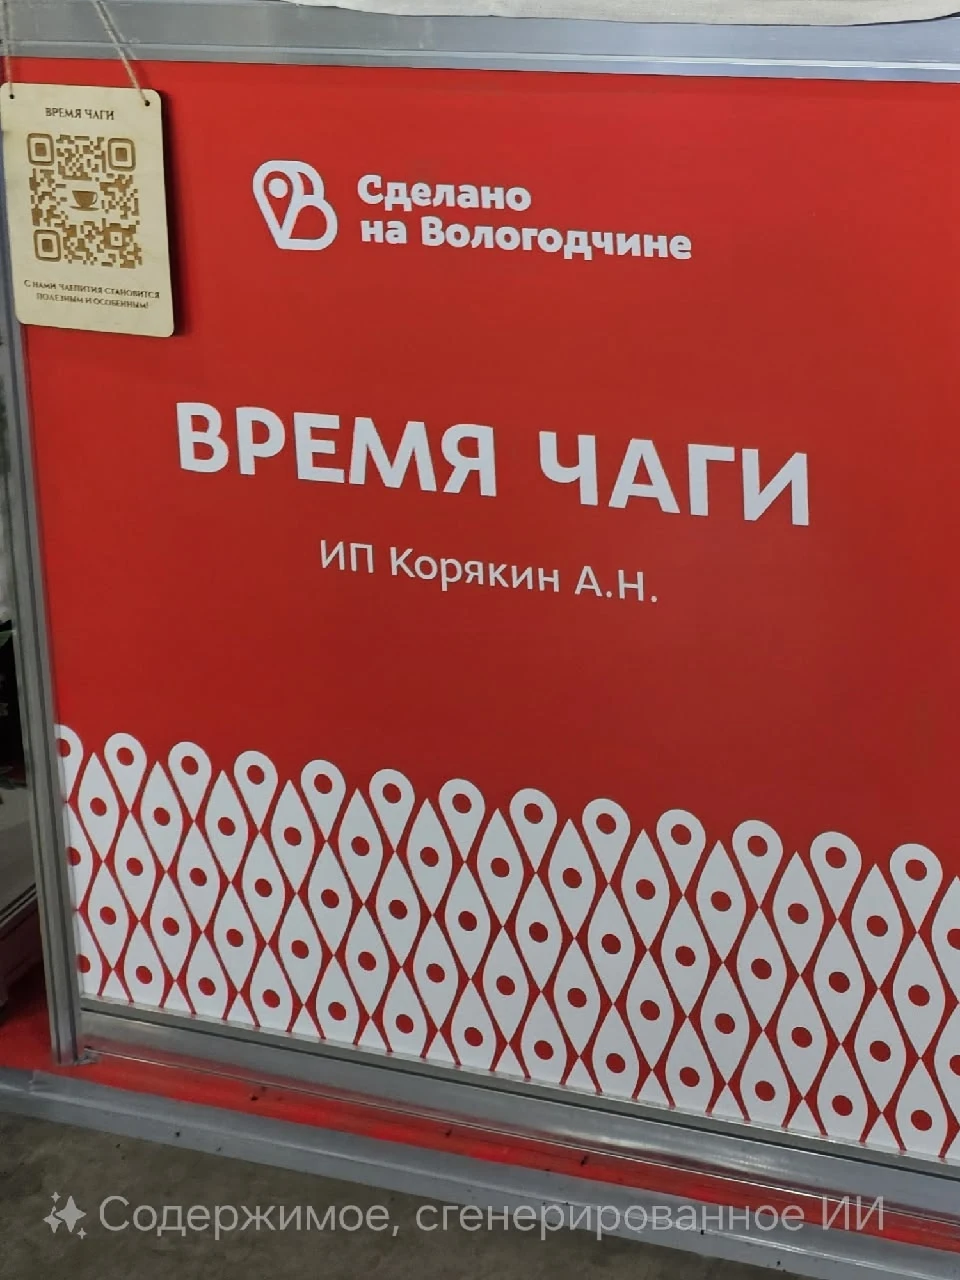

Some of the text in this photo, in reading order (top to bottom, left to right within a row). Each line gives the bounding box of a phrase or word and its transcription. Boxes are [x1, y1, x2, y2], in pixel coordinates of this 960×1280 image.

[45, 107, 115, 121] ВРЕМЯ ЧАГИ
[357, 174, 531, 212] Сделано
[360, 216, 692, 261] на Вологодчине
[32, 281, 56, 289] НАМИ
[104, 287, 160, 299] СТАНОВИТСЯ
[36, 292, 84, 304] ПОЛЕЗНЫМ
[93, 297, 149, 309] ОСОБЕННЫМ!
[176, 402, 809, 526] ВРЕМЯ ЧАГИ
[320, 540, 657, 603] ИП Корякин А.Н.
